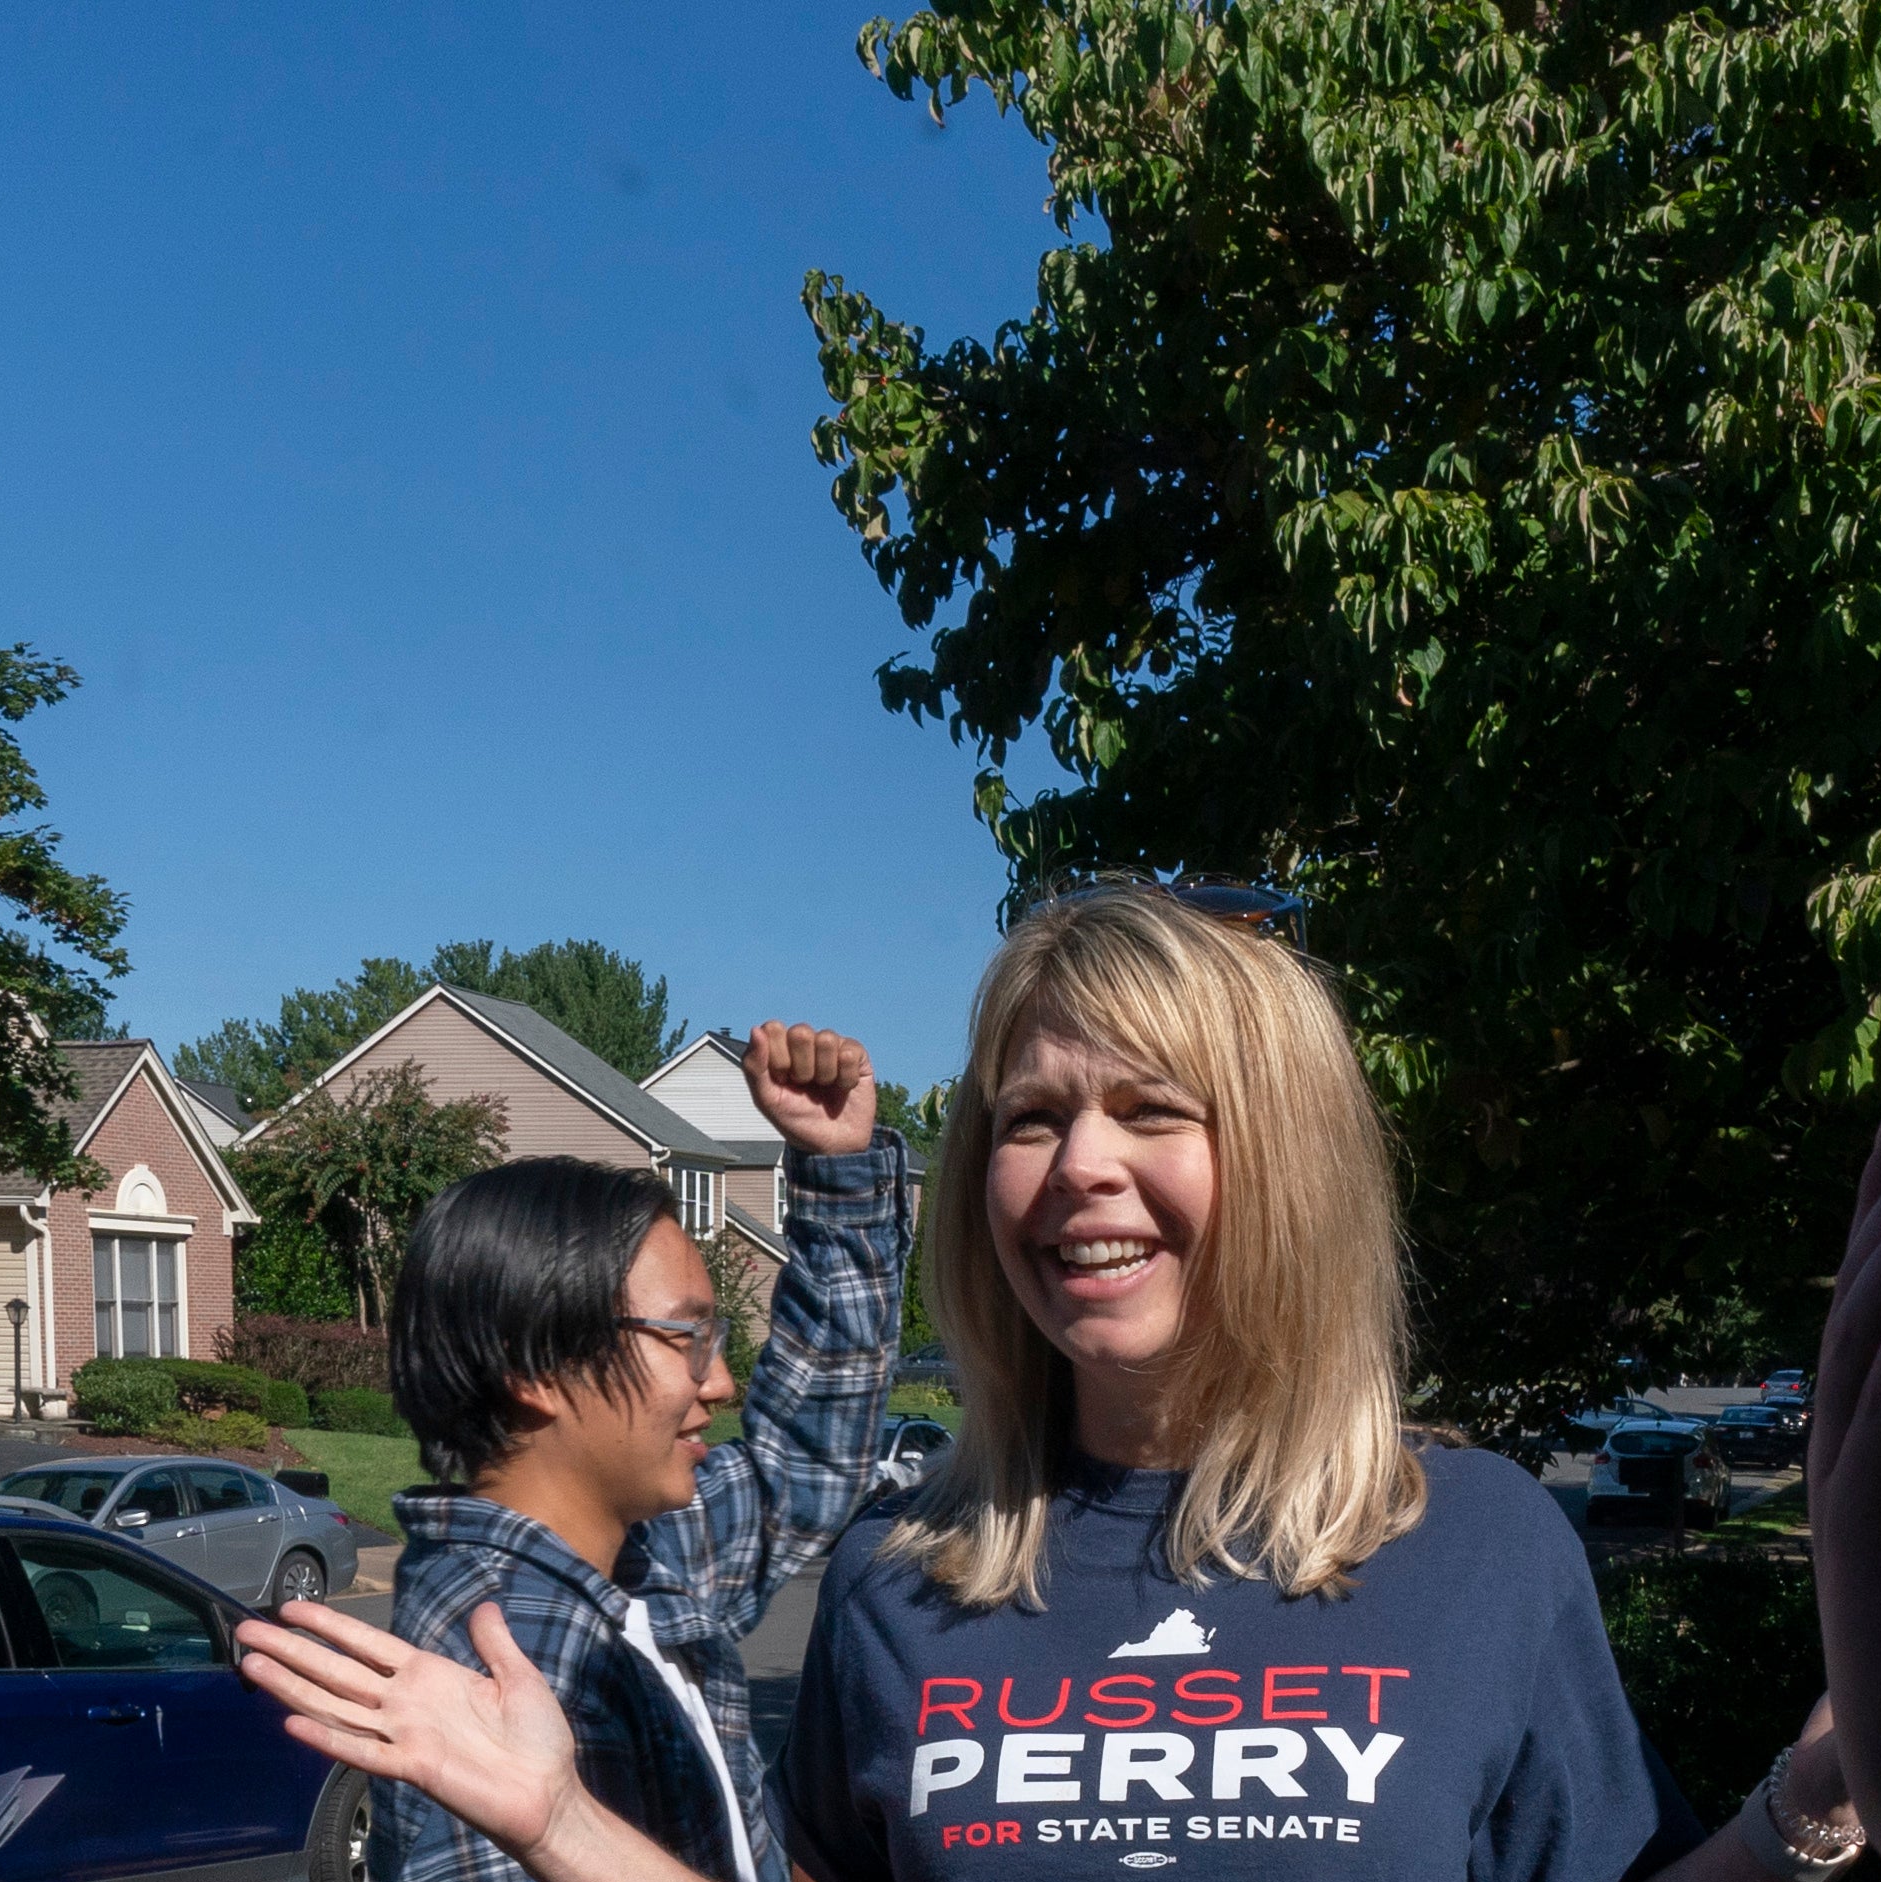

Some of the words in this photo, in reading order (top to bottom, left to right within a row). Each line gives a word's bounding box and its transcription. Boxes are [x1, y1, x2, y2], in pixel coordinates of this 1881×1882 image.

[917, 1665, 1411, 1736] RUSSET
[909, 1726, 1406, 1818] PERRY
[942, 1820, 1022, 1849] FOR
[1036, 1817, 1172, 1842] STATE
[1185, 1815, 1361, 1844] SENATE
